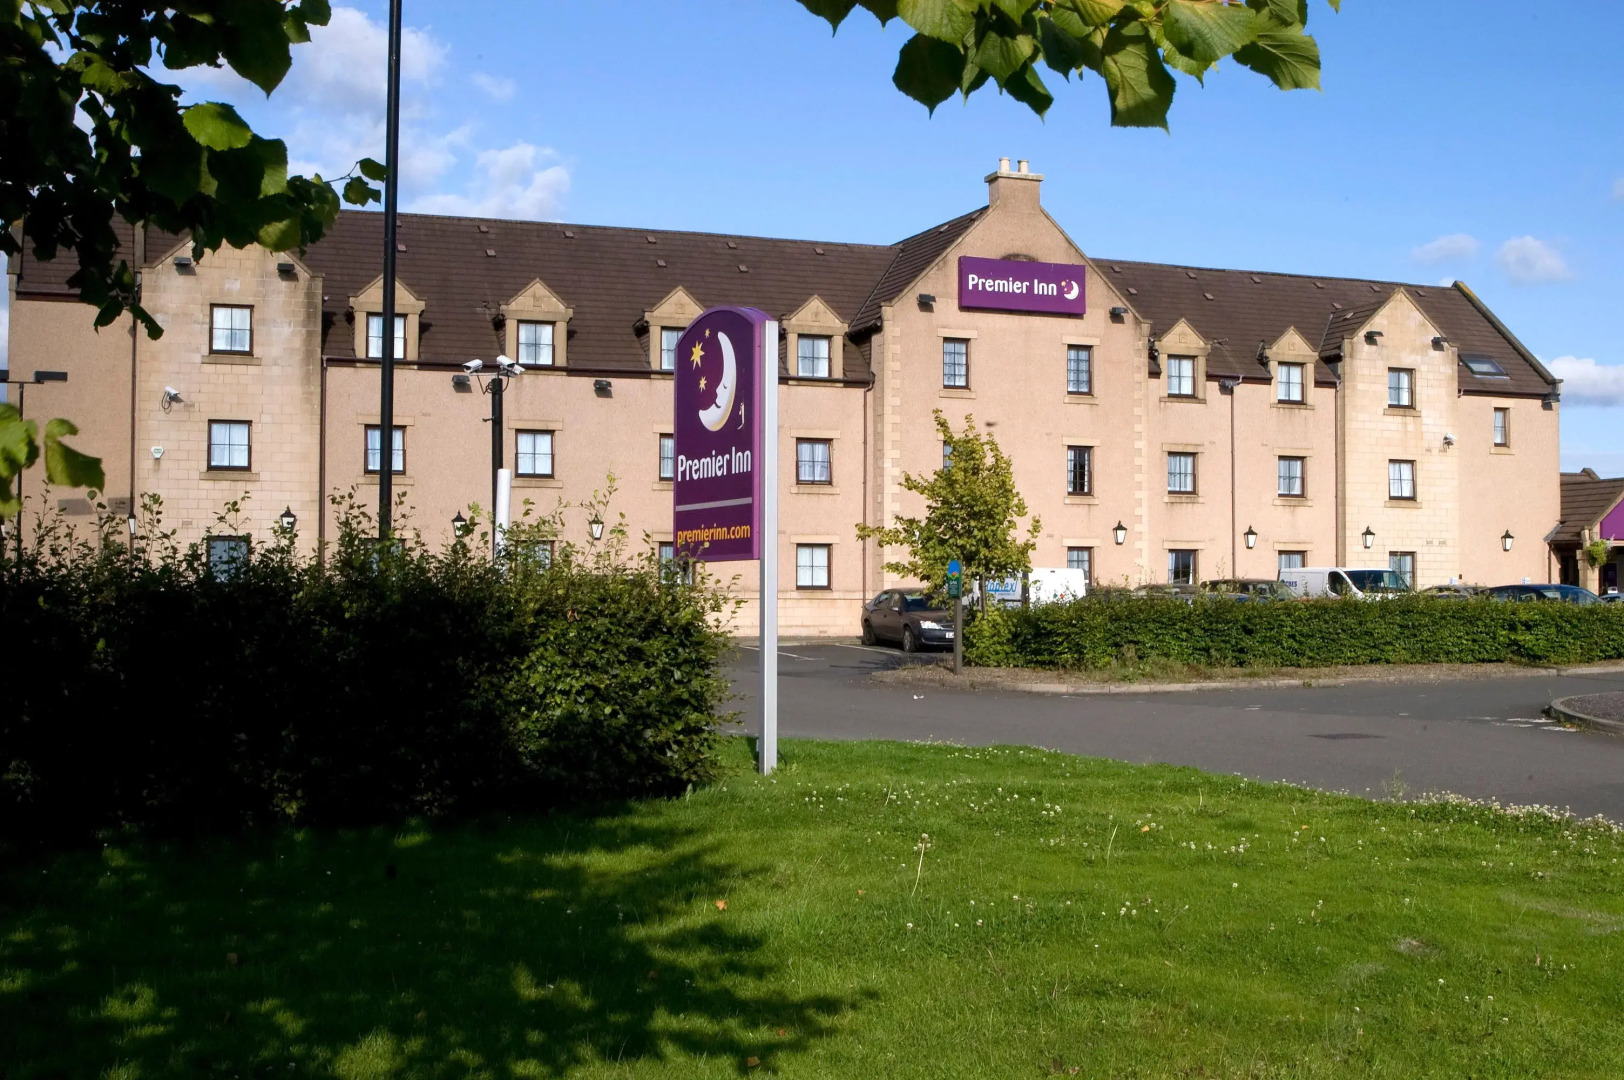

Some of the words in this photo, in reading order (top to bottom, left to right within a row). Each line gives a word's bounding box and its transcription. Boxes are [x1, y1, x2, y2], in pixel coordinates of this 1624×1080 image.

[968, 274, 1030, 294] Premier
[1033, 279, 1057, 296] Inn
[677, 450, 729, 481] Premier
[731, 446, 751, 474] Inn
[677, 523, 750, 547] premierinn.com
